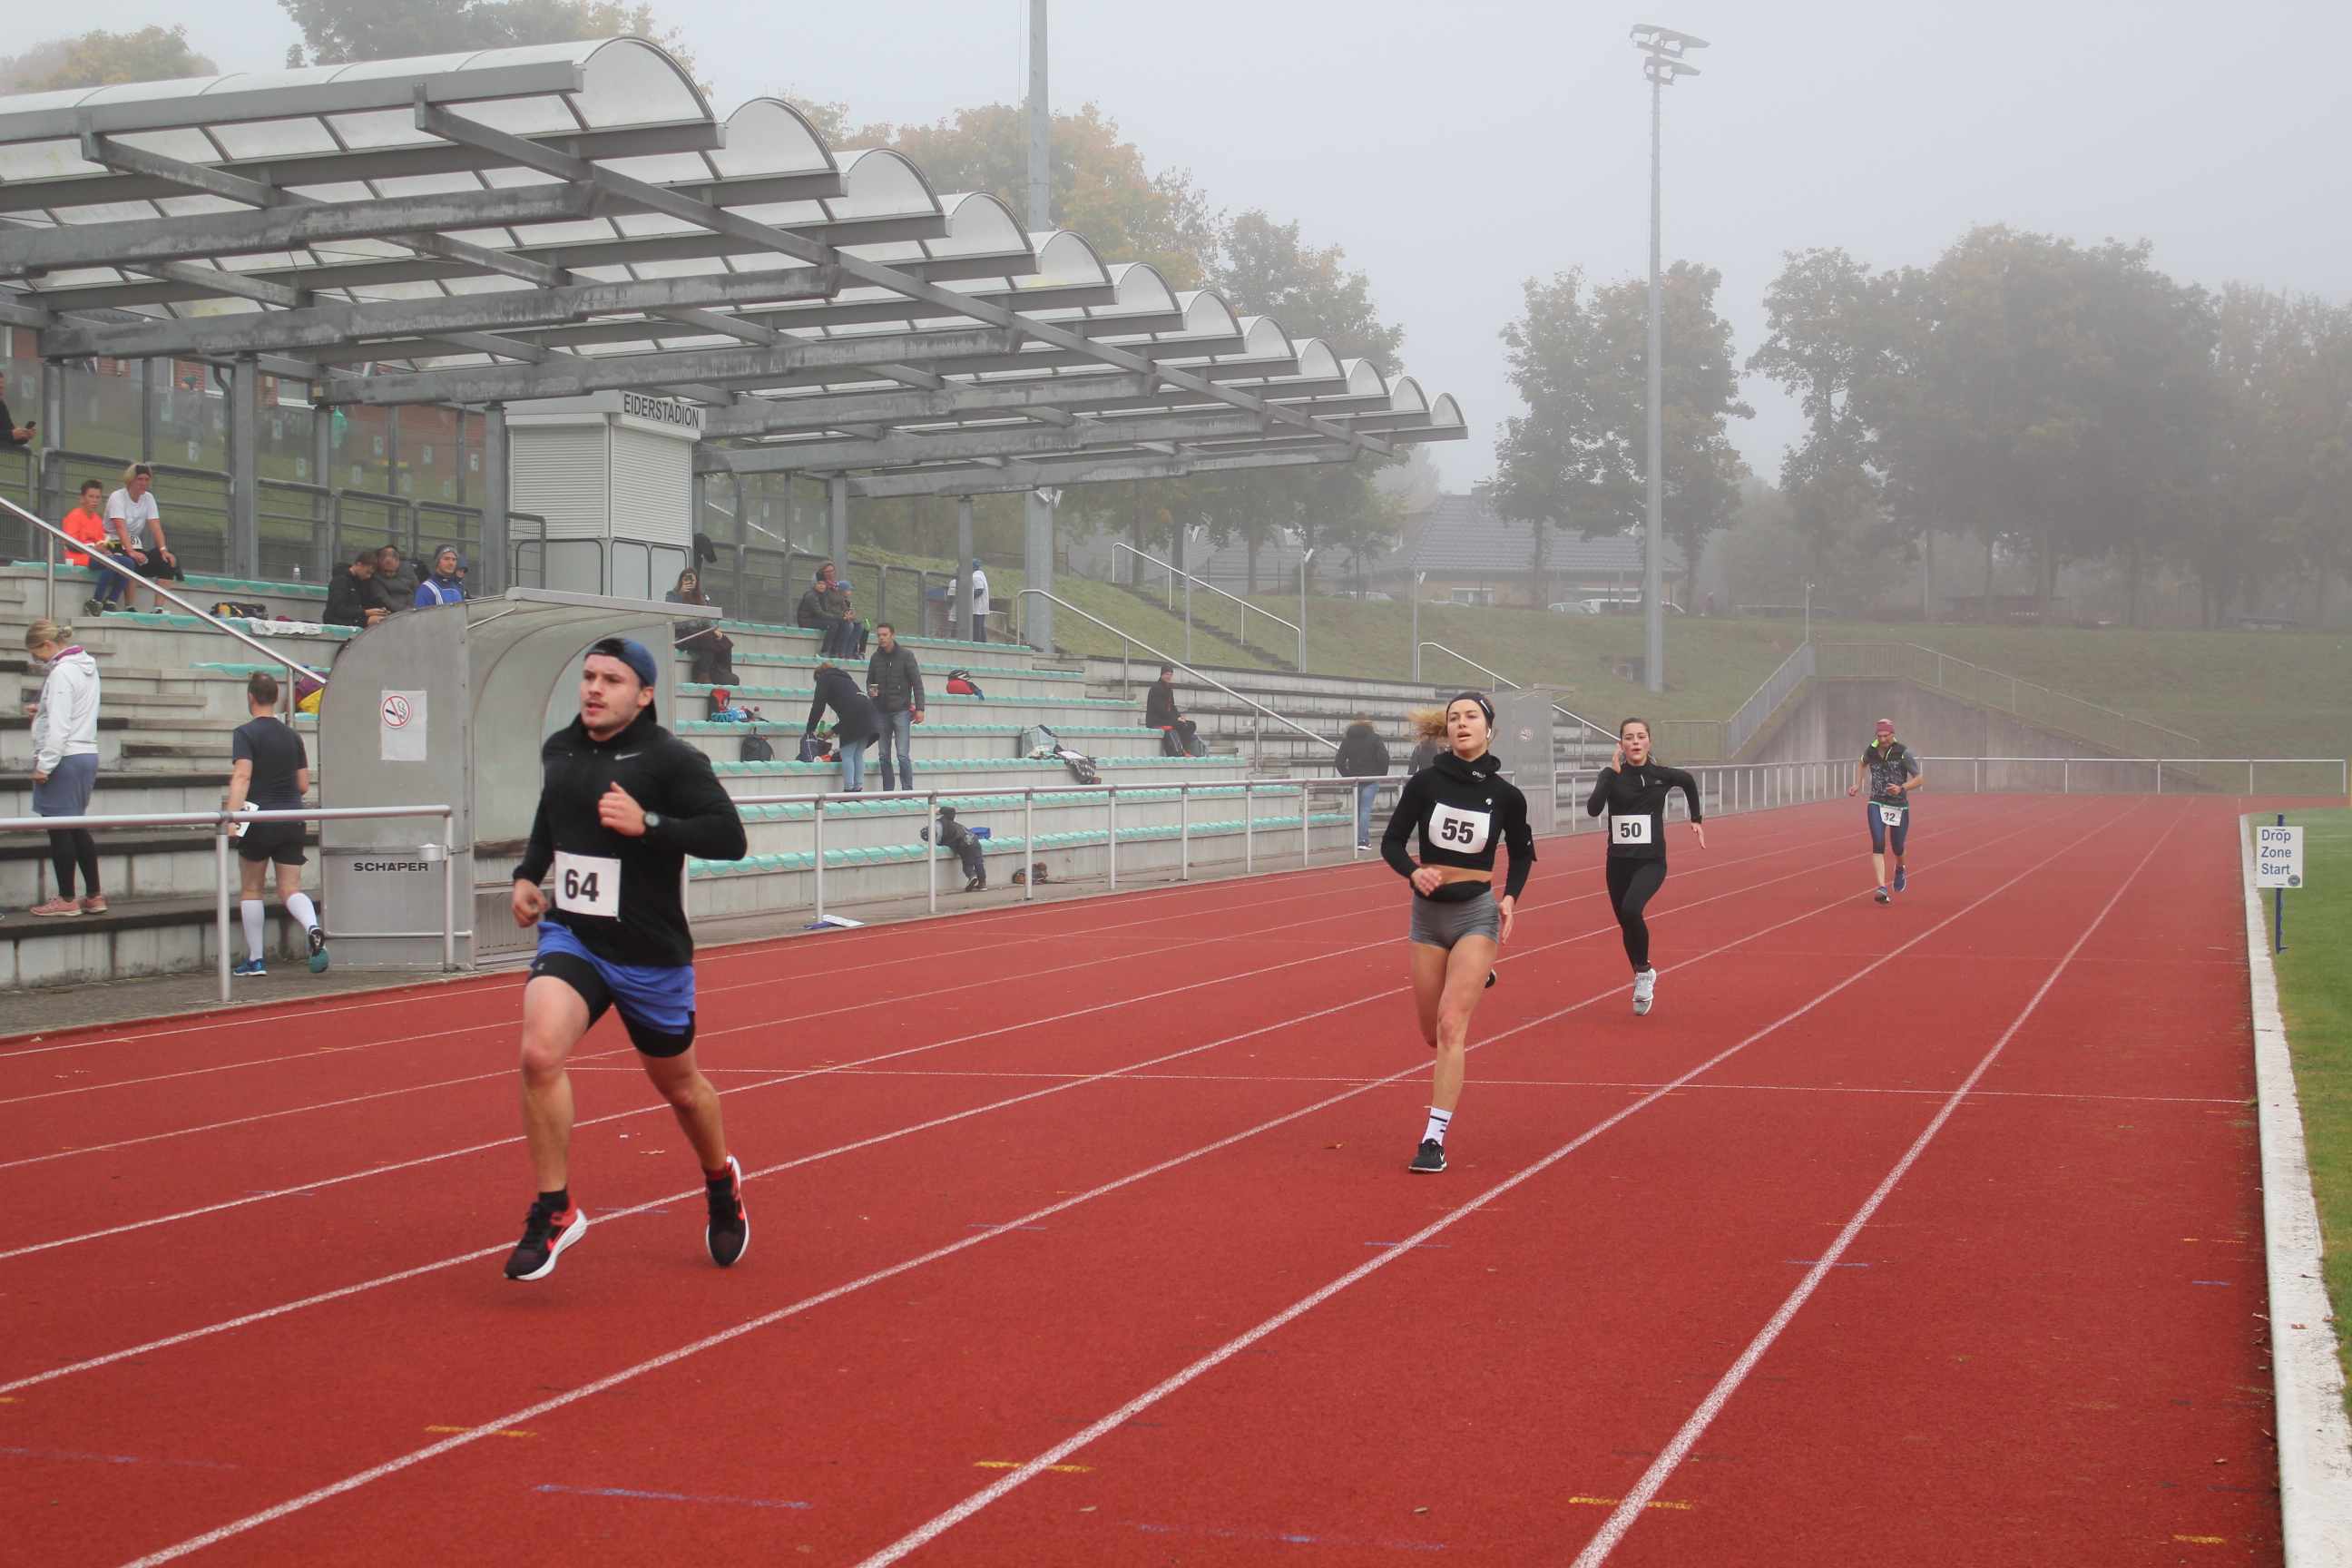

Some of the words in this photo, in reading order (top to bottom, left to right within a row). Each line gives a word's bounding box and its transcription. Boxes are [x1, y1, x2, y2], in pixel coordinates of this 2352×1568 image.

[623, 393, 700, 428] EIDERSTADION
[1884, 812, 1896, 822] 32
[1442, 818, 1475, 844] 55
[1621, 822, 1642, 838] 50
[2261, 829, 2291, 843] Drop
[2261, 847, 2292, 858] Zone
[2261, 863, 2290, 875] Start
[565, 868, 600, 902] 64
